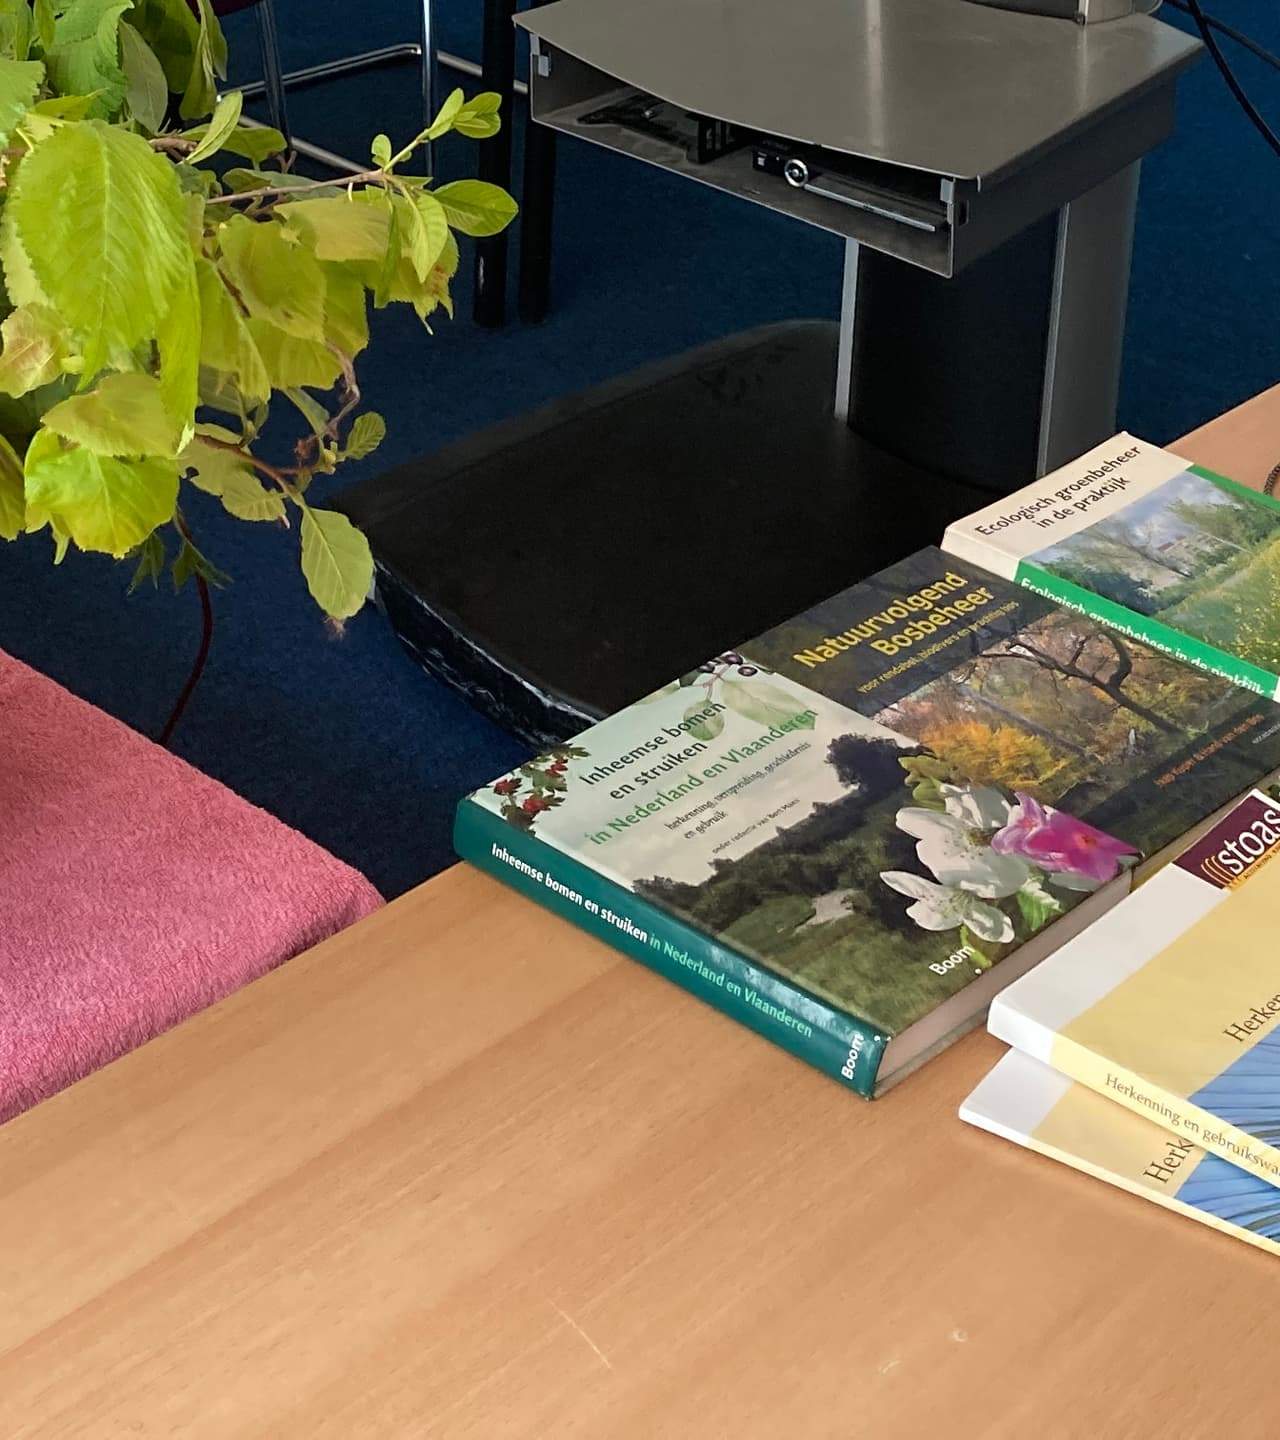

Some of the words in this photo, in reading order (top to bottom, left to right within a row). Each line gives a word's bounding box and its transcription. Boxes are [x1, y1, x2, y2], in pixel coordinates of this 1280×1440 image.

[975, 492, 1055, 536] Ecologisch
[1054, 445, 1142, 502] groenbeheer
[1035, 513, 1053, 530] in
[1053, 501, 1074, 521] de
[1075, 474, 1132, 514] praktijk
[793, 571, 969, 669] Natuurvolgend
[870, 586, 995, 656] Bosbeheer
[580, 732, 666, 786] Inheemse
[665, 699, 727, 738] bomen
[609, 781, 631, 801] en
[634, 739, 709, 789] struiken
[584, 824, 612, 847] in
[613, 773, 702, 834] Nederland
[703, 762, 728, 779] en
[721, 708, 820, 764] Vlaanderen
[684, 829, 696, 840] en
[695, 811, 728, 834] gebruik
[491, 842, 544, 885] Inheemse
[545, 870, 583, 905] bomen
[584, 896, 599, 915] en
[601, 903, 648, 944] struiken
[649, 932, 661, 949] in
[663, 941, 725, 988] Nederland
[726, 979, 742, 997] en
[743, 987, 813, 1039] Vlaanderen
[928, 945, 975, 975] Boom
[841, 1032, 865, 1080] Boom
[1105, 1072, 1182, 1130] Herkenning
[1182, 1117, 1200, 1134] en
[1142, 1137, 1194, 1184] Herk
